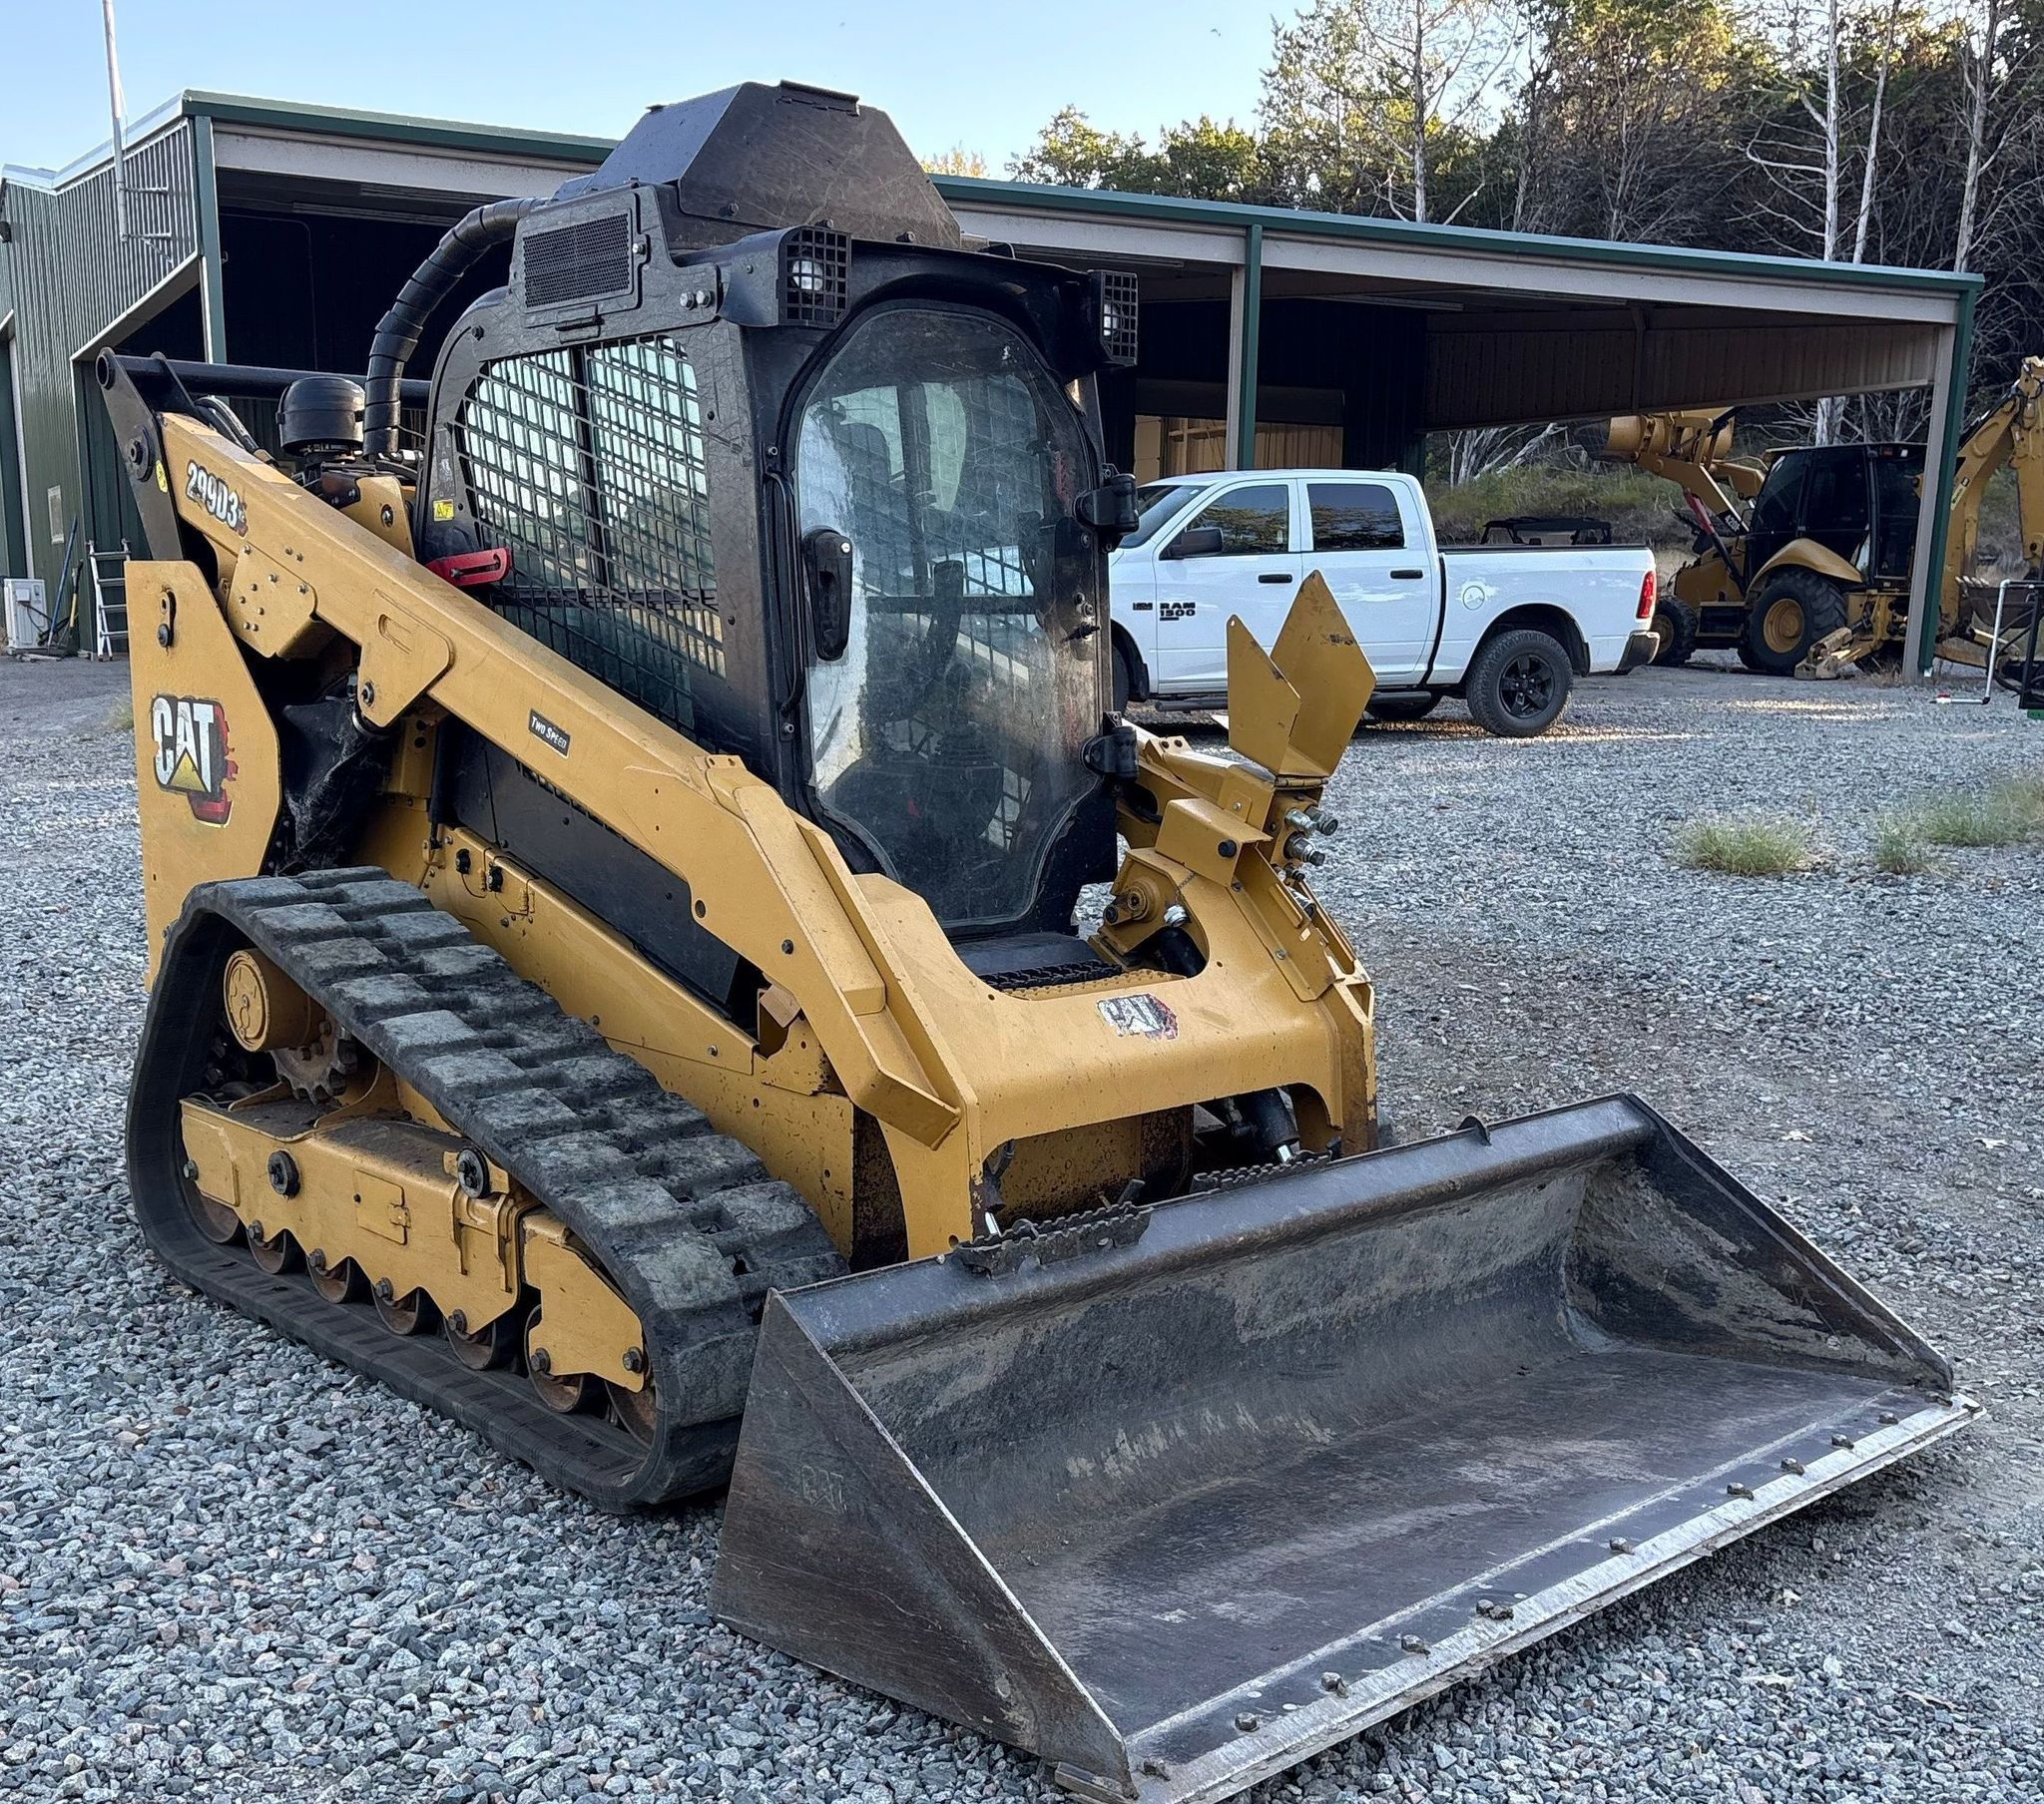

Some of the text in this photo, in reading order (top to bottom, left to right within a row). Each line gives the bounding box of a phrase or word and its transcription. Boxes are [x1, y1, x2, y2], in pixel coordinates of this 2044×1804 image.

[187, 461, 240, 529] 299D3
[152, 696, 215, 793] CAT
[1098, 996, 1161, 1034] CAT
